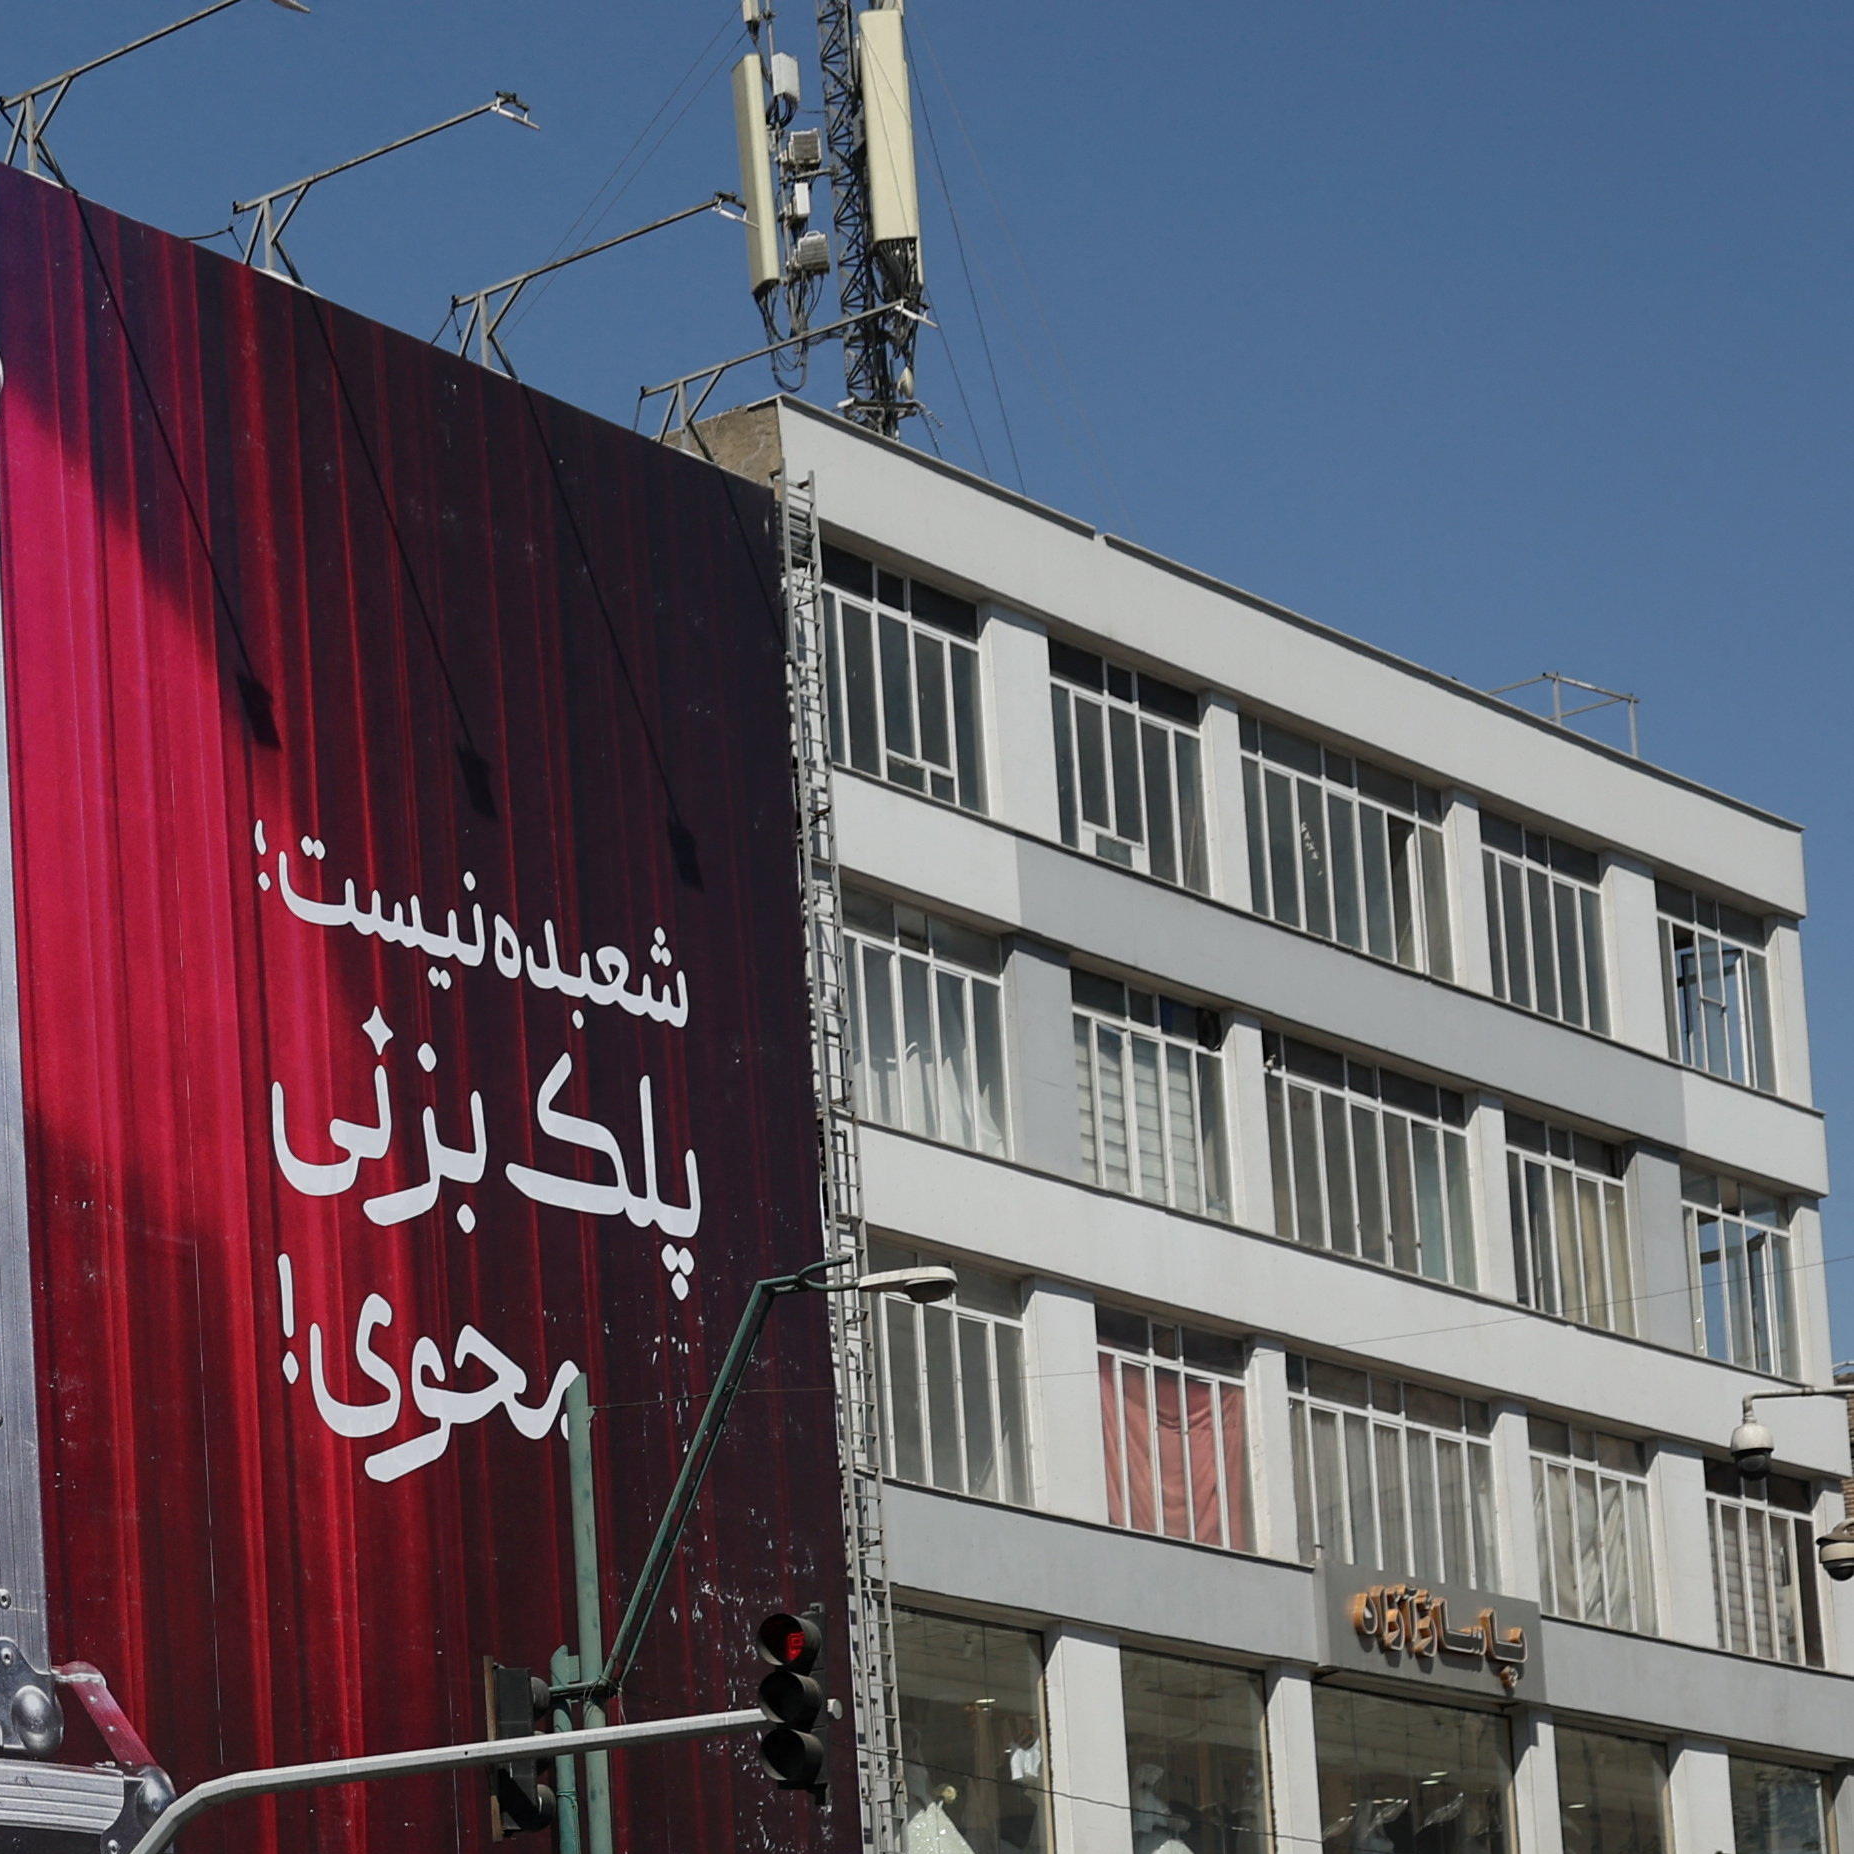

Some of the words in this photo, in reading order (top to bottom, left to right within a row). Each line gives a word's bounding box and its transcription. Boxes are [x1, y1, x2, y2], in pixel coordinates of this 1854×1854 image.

[494, 919, 690, 1030] شعبده
[271, 1005, 488, 1234] بزنی
[505, 1051, 703, 1302] پلک
[1350, 1583, 1418, 1650] آزاد
[1412, 1588, 1528, 1689] پاساژ
